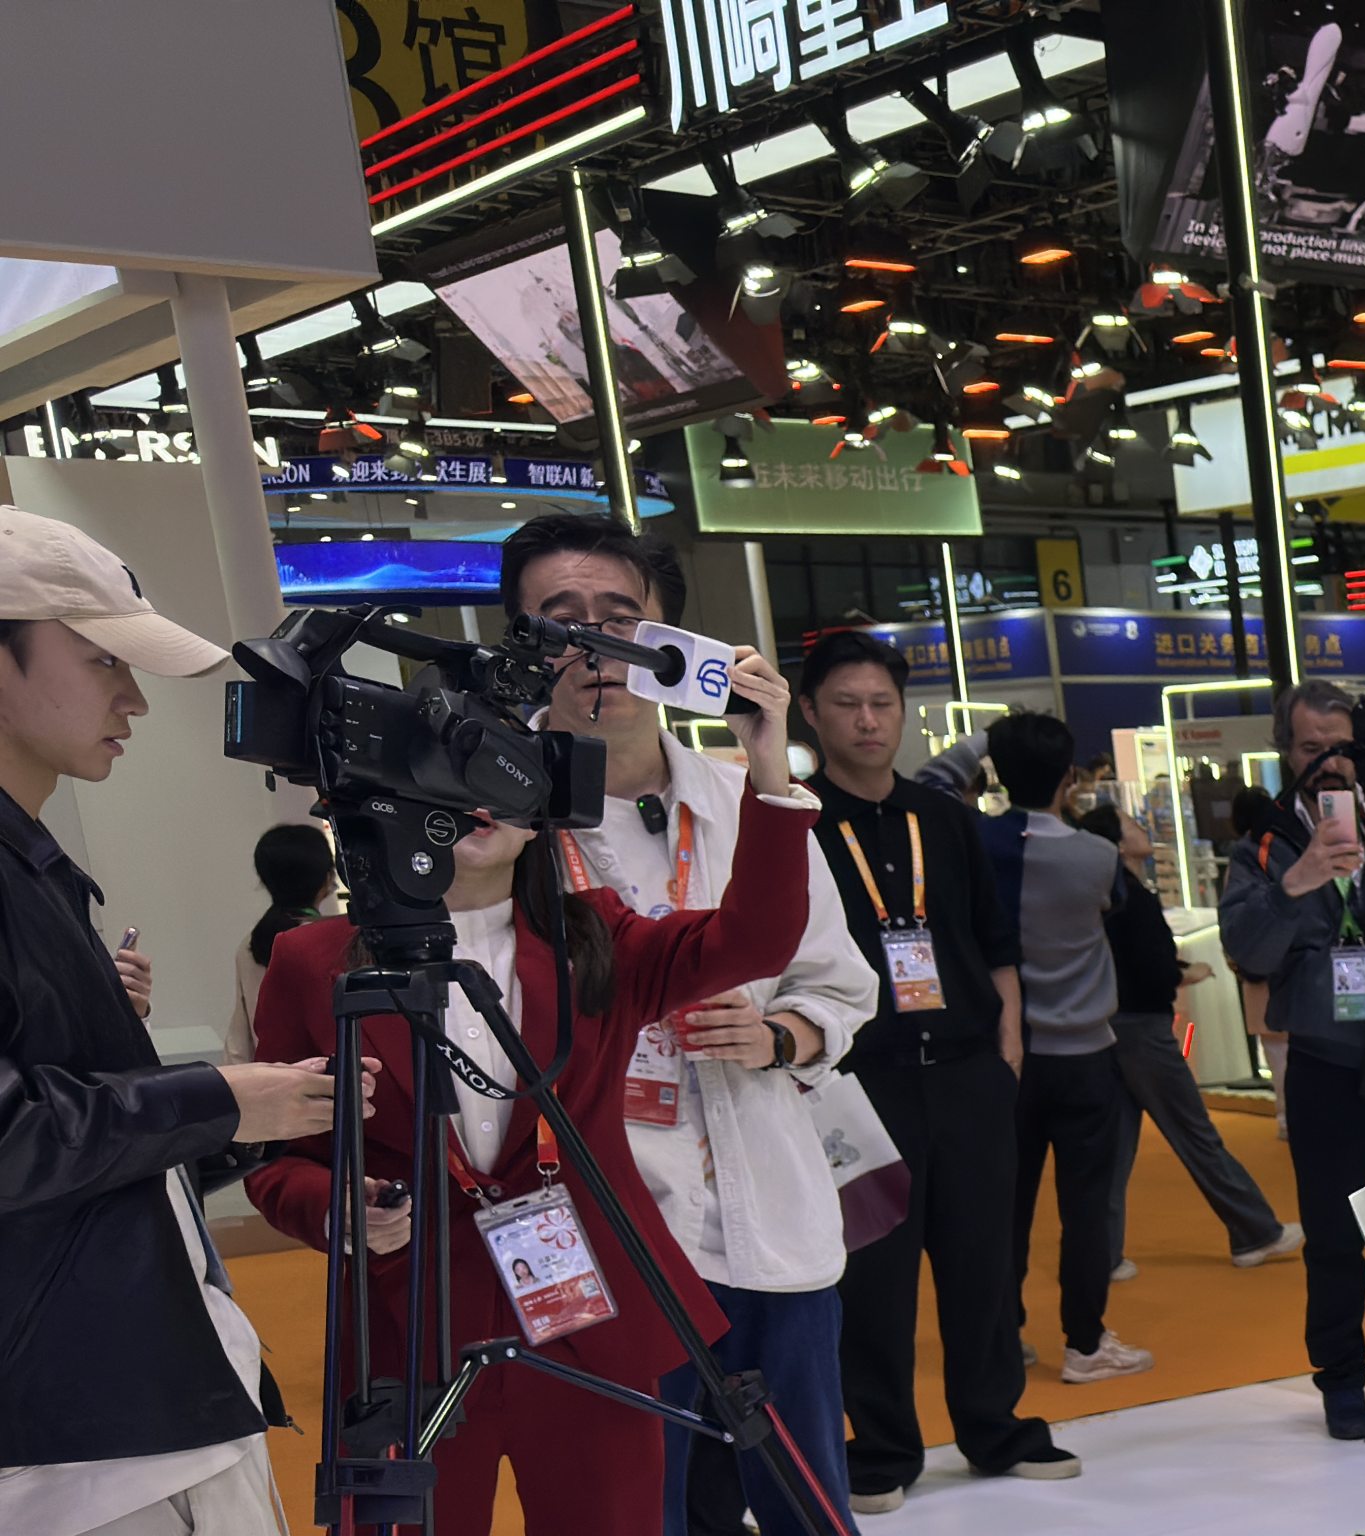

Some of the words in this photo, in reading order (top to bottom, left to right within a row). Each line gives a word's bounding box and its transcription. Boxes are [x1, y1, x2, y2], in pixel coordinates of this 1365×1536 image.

[1187, 219, 1205, 232] In
[1183, 232, 1227, 248] devic
[1261, 242, 1289, 256] not
[1290, 244, 1330, 262] place
[1052, 569, 1073, 602] 6
[495, 754, 534, 788] SONY
[436, 1043, 507, 1099] SONY
